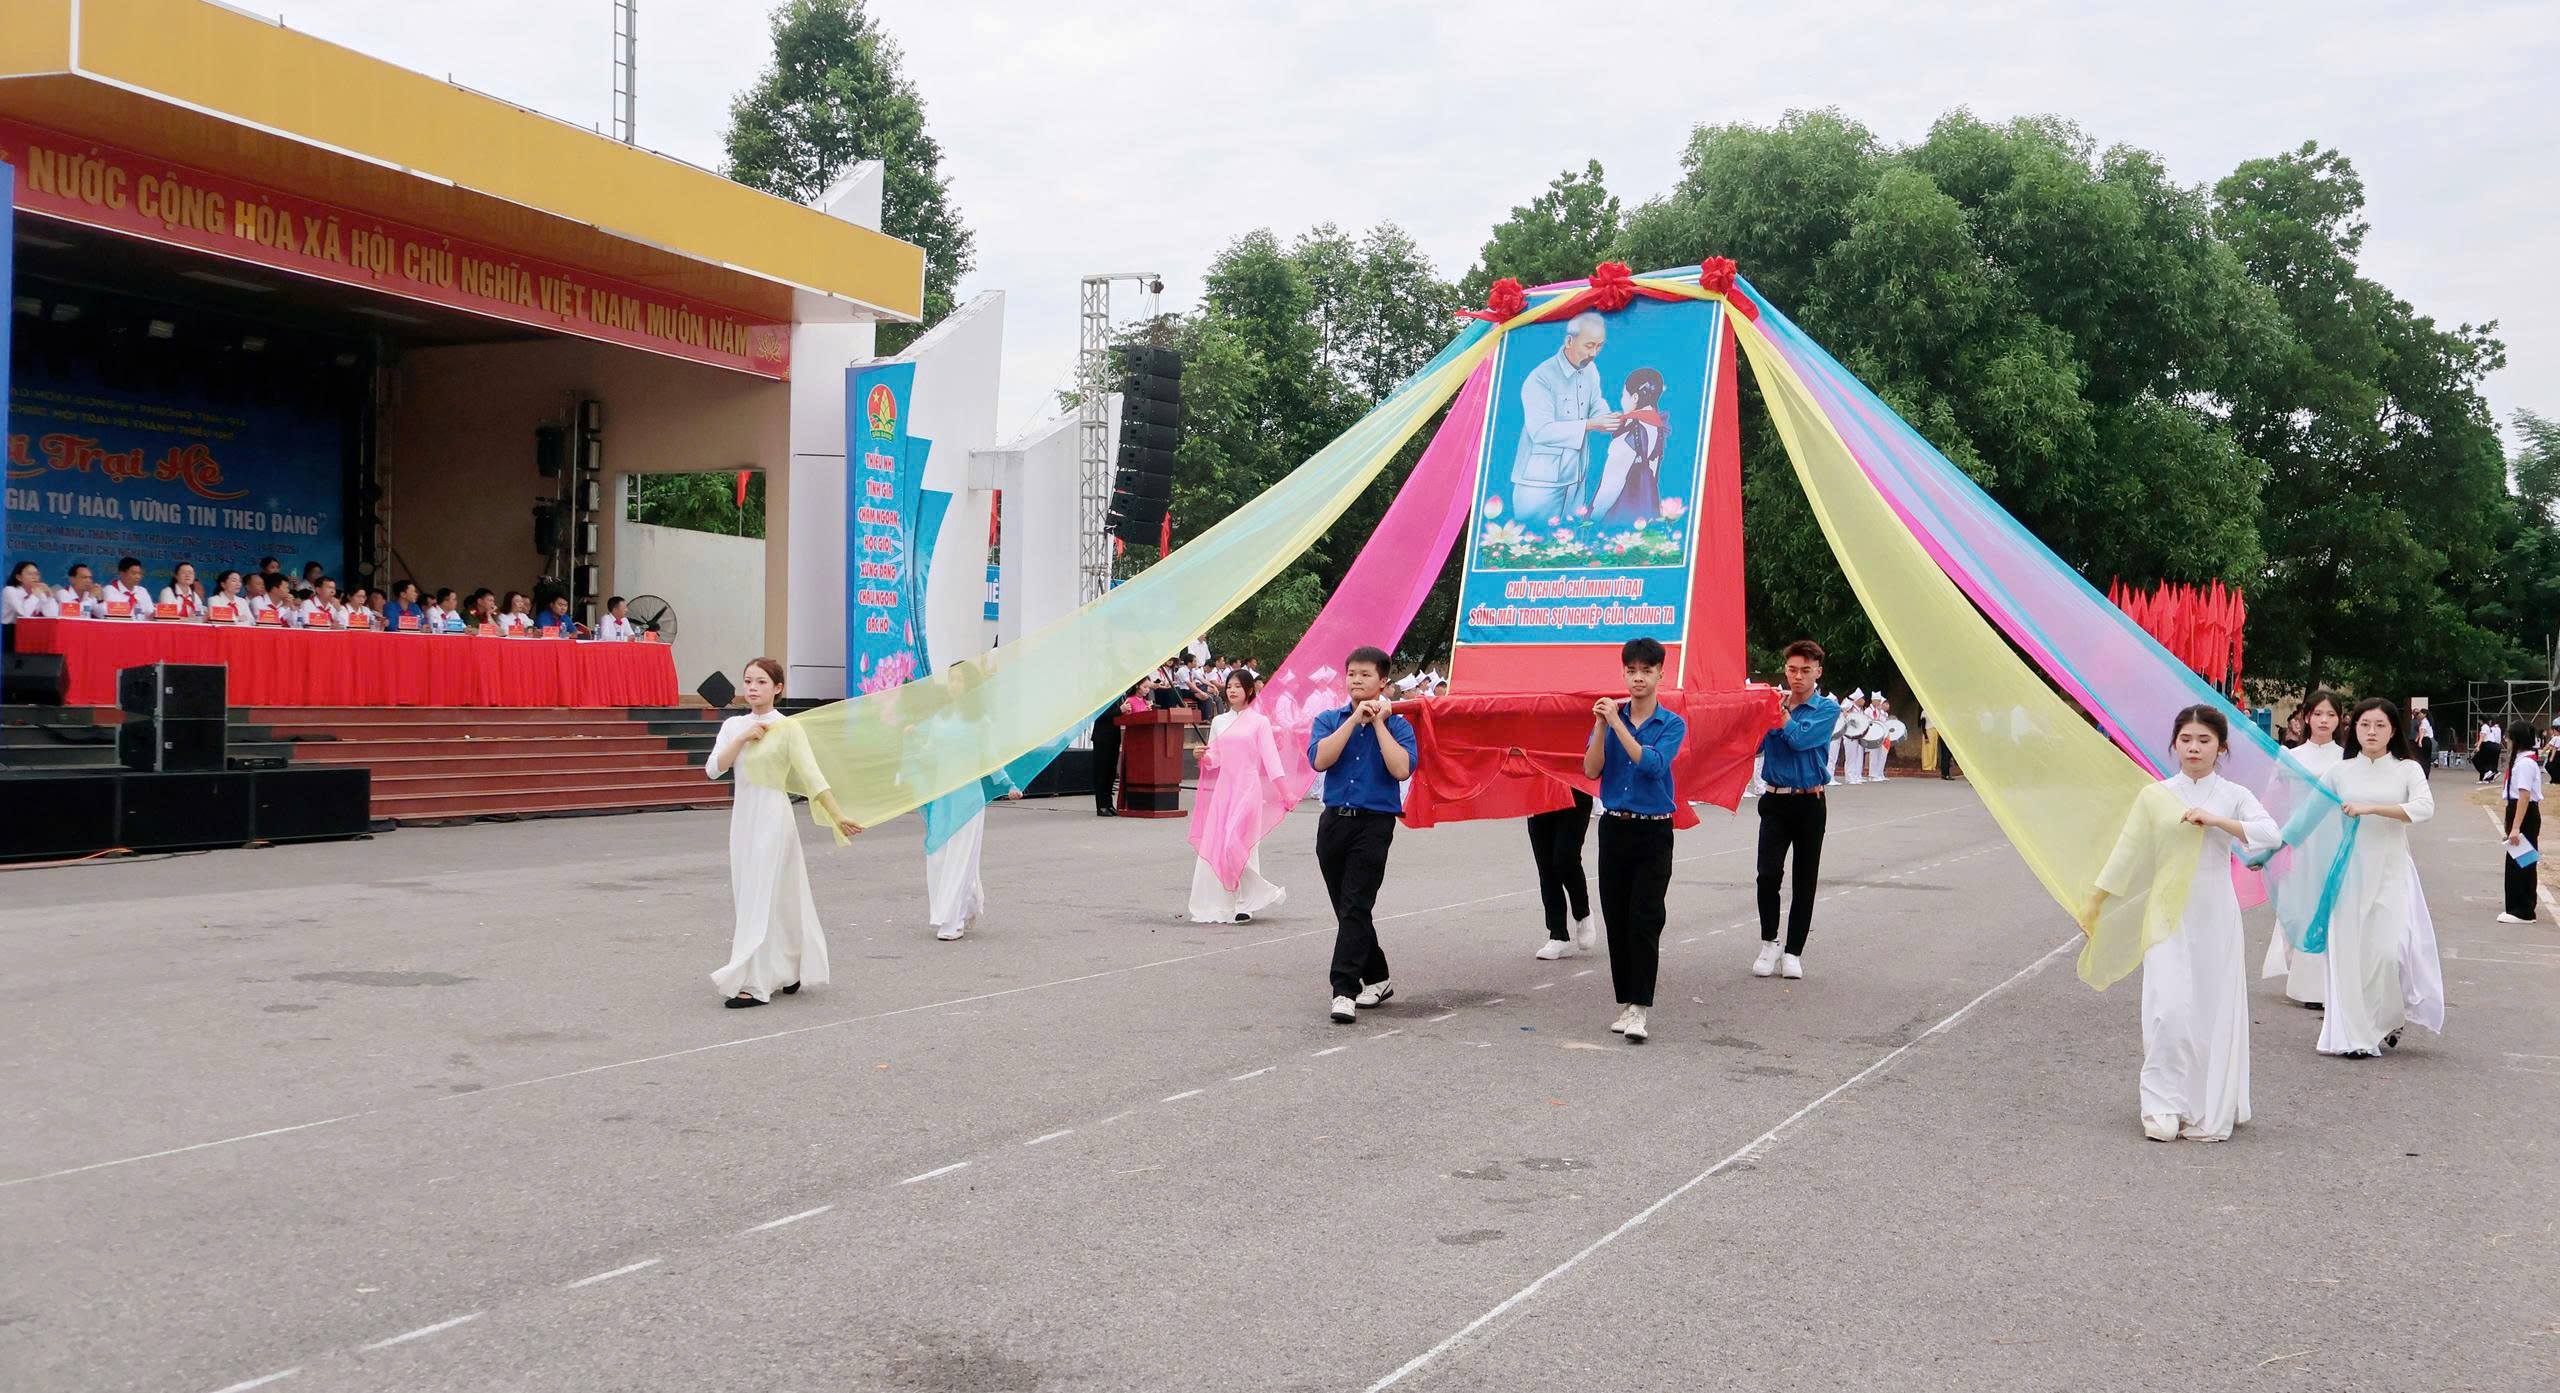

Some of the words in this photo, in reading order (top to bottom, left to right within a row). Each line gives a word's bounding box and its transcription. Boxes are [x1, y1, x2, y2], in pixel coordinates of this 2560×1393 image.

[28, 146, 126, 210] NƯỚC
[137, 173, 225, 235] CỘNG
[235, 195, 295, 251] HÒA
[301, 216, 341, 262] XÃ
[350, 226, 396, 279] HỘI
[403, 239, 453, 288] CHỦ
[460, 257, 533, 308] NGHĨA
[539, 274, 586, 322] VIỆT
[590, 291, 641, 331] NAM
[646, 303, 703, 346] MUÔN
[708, 317, 749, 357] NĂM
[41, 433, 149, 483] Trại
[155, 443, 249, 500] Hè
[883, 455, 894, 472] NHI
[881, 482, 893, 499] GIA
[6, 488, 40, 512] GIA
[46, 490, 74, 520] TỰ
[78, 491, 124, 522] HÀO,
[131, 497, 181, 525] VỮNG
[187, 505, 217, 528] TIN
[222, 508, 266, 532] THEO
[875, 590, 898, 607] NGOAN
[1505, 576, 1527, 598] CHỦ
[1528, 580, 1550, 602] TỊCH
[1566, 576, 1585, 597] CHÍ
[1584, 579, 1612, 597] MINH
[1613, 575, 1625, 597] VĨ
[1624, 578, 1644, 600] ĐẠI
[1469, 603, 1495, 627] SỐNG
[1496, 605, 1516, 626] MÃI
[1517, 608, 1549, 626] TRONG
[1550, 606, 1567, 629] SỰ
[1565, 603, 1603, 629] NGHIỆP
[1604, 601, 1625, 625] CỦA
[1626, 603, 1661, 625] CHÚNG
[1662, 606, 1675, 625] TA
